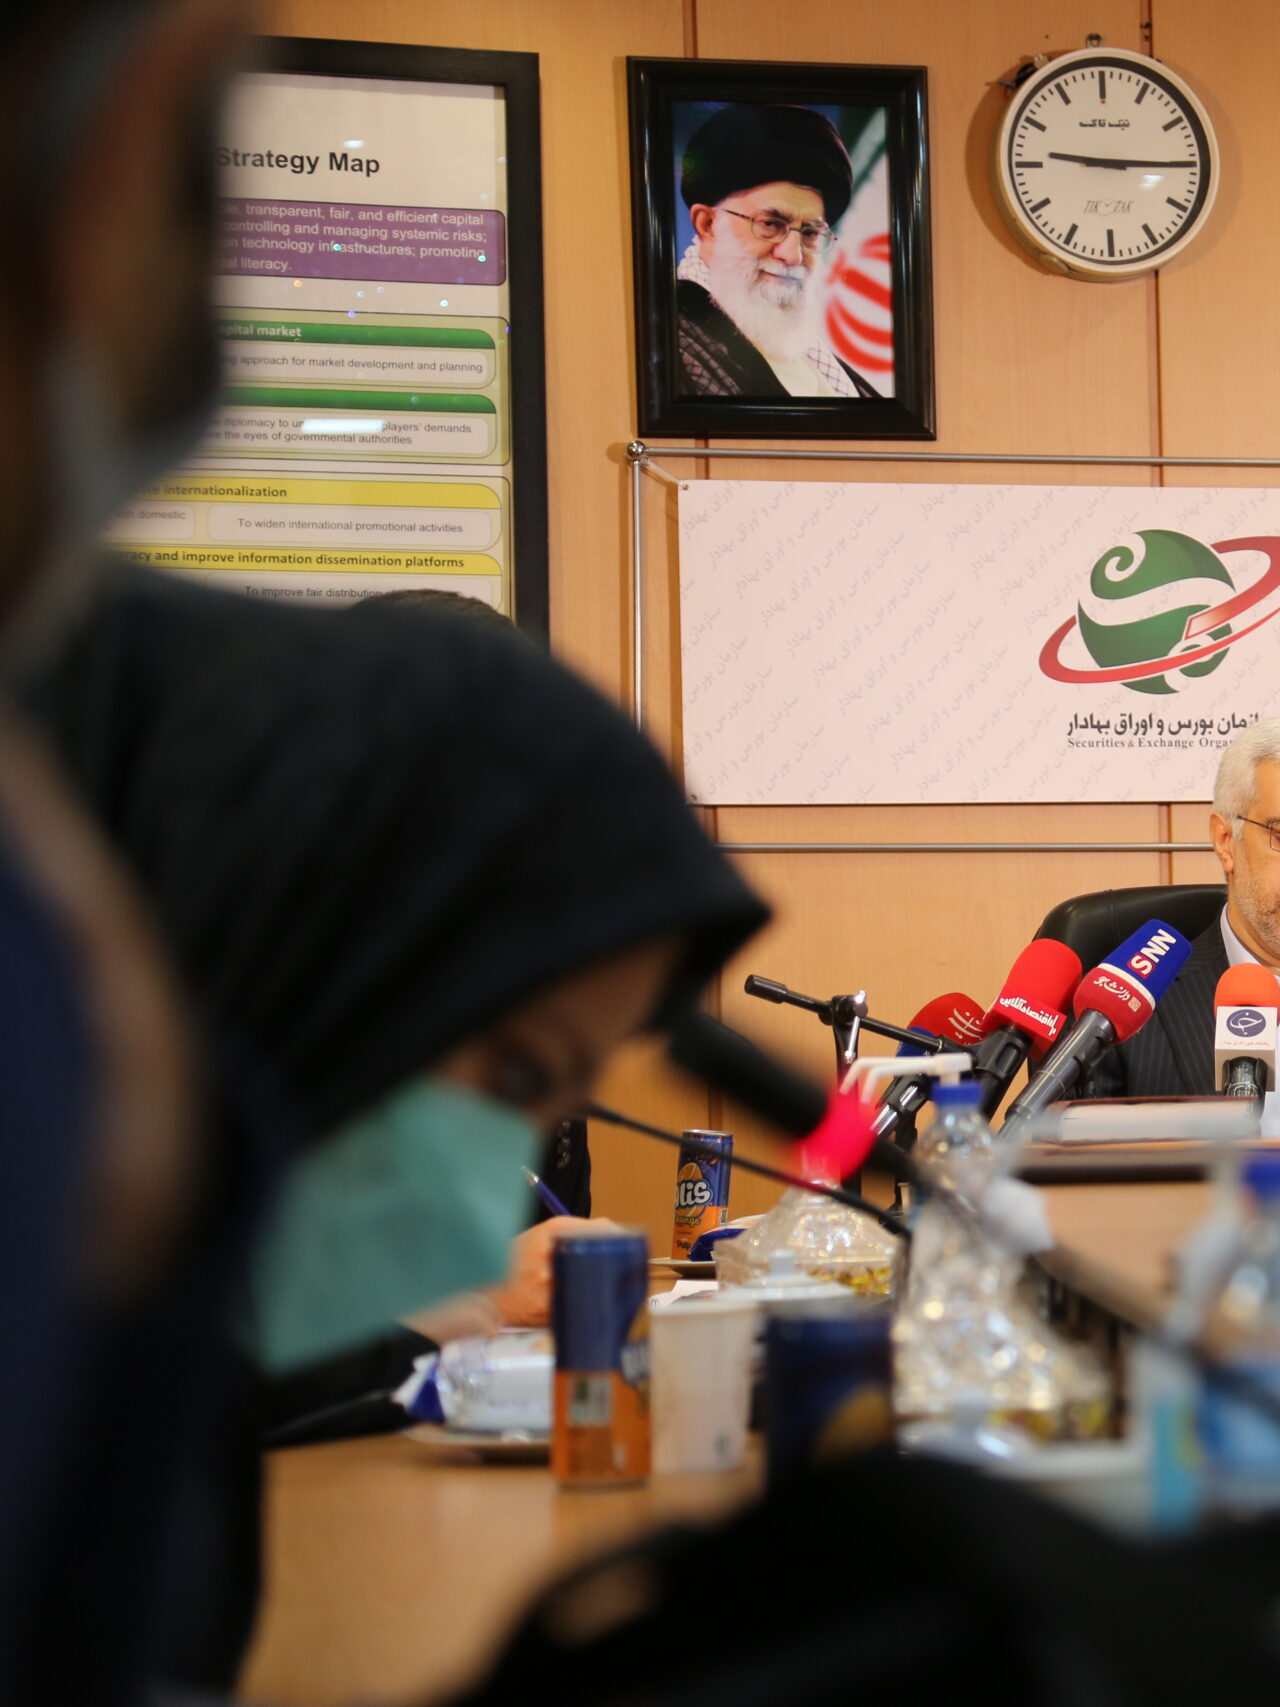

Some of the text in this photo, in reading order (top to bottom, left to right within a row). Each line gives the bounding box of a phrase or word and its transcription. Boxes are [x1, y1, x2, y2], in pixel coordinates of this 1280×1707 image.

[216, 149, 380, 177] Strategy Map
[1084, 200, 1135, 213] TIK TAK
[246, 204, 325, 219] transparent,
[330, 207, 354, 221] fair,
[359, 210, 382, 220] and
[387, 212, 438, 223] efficient
[441, 214, 483, 226] capital
[294, 223, 318, 234] and
[324, 226, 388, 239] managing
[392, 228, 450, 240] systemic
[453, 230, 486, 242] risks;
[242, 239, 314, 252] technology
[241, 258, 292, 272] literacy.
[258, 326, 301, 337] market
[241, 355, 288, 366] approach
[292, 356, 305, 366] for
[309, 358, 344, 368] market
[348, 360, 414, 370] development
[417, 362, 436, 370] and
[440, 362, 482, 373] planning
[224, 418, 274, 429] diplomacy
[279, 419, 288, 427] to
[424, 424, 471, 433] demands
[224, 431, 240, 440] the
[244, 432, 268, 442] eyes
[272, 432, 282, 440] of
[285, 432, 356, 443] governmental
[359, 434, 412, 444] authorities
[164, 485, 287, 498] internationalization
[138, 509, 186, 520] domestic
[238, 519, 463, 533] To widen international promotional activities
[155, 550, 178, 561] and
[182, 551, 234, 564] improve
[238, 553, 311, 564] information
[316, 554, 401, 566] dissemination
[406, 556, 464, 568] platforms
[261, 587, 303, 599] improve
[307, 587, 322, 597] fair
[1067, 712, 1110, 736] بهادار
[1114, 712, 1153, 735] اوراق
[1157, 720, 1164, 735] و
[1168, 719, 1213, 735] بورس
[1067, 737, 1125, 748] Securities
[1138, 738, 1194, 749] Exchange
[1131, 929, 1176, 975] SNN
